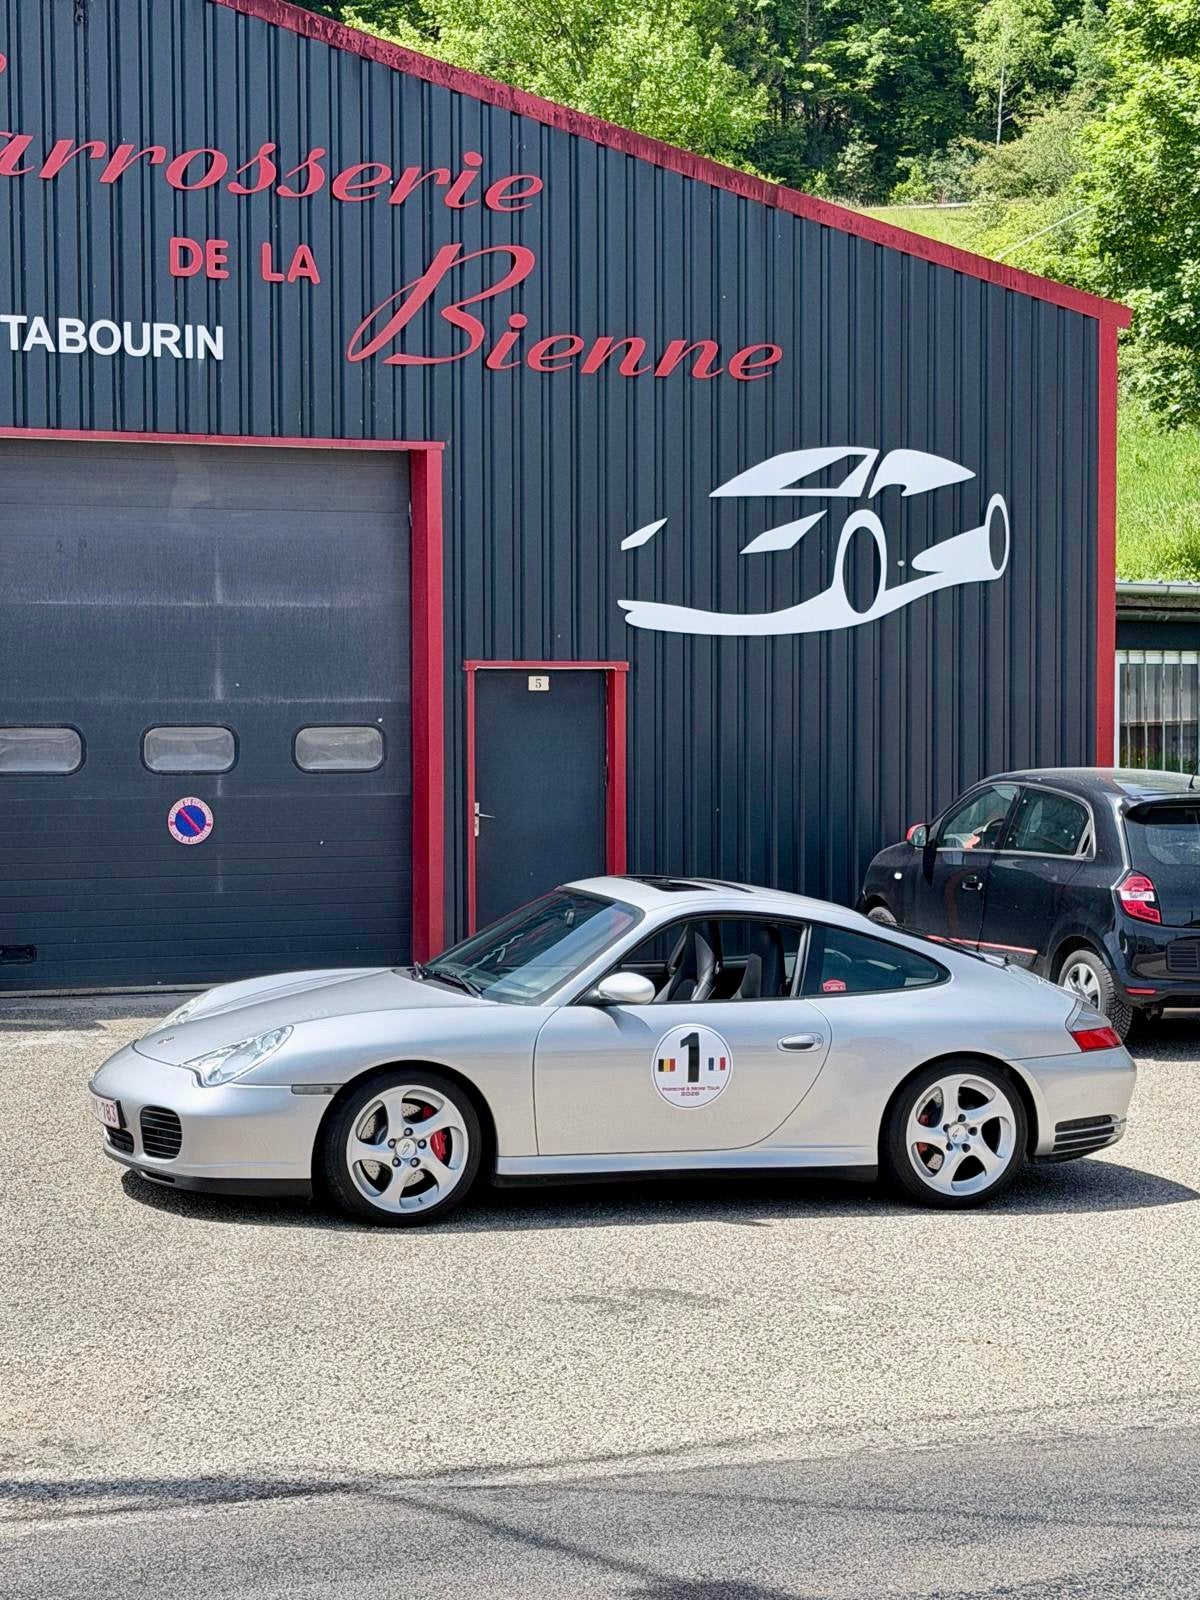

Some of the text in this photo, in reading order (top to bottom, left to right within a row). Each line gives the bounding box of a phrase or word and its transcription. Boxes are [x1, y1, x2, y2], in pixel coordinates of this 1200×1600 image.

[0, 130, 545, 213] arrosserie
[169, 236, 783, 381] DE LA Bienne
[0, 314, 224, 361] TABOURIN
[535, 678, 542, 689] 5
[680, 1032, 700, 1083] 1
